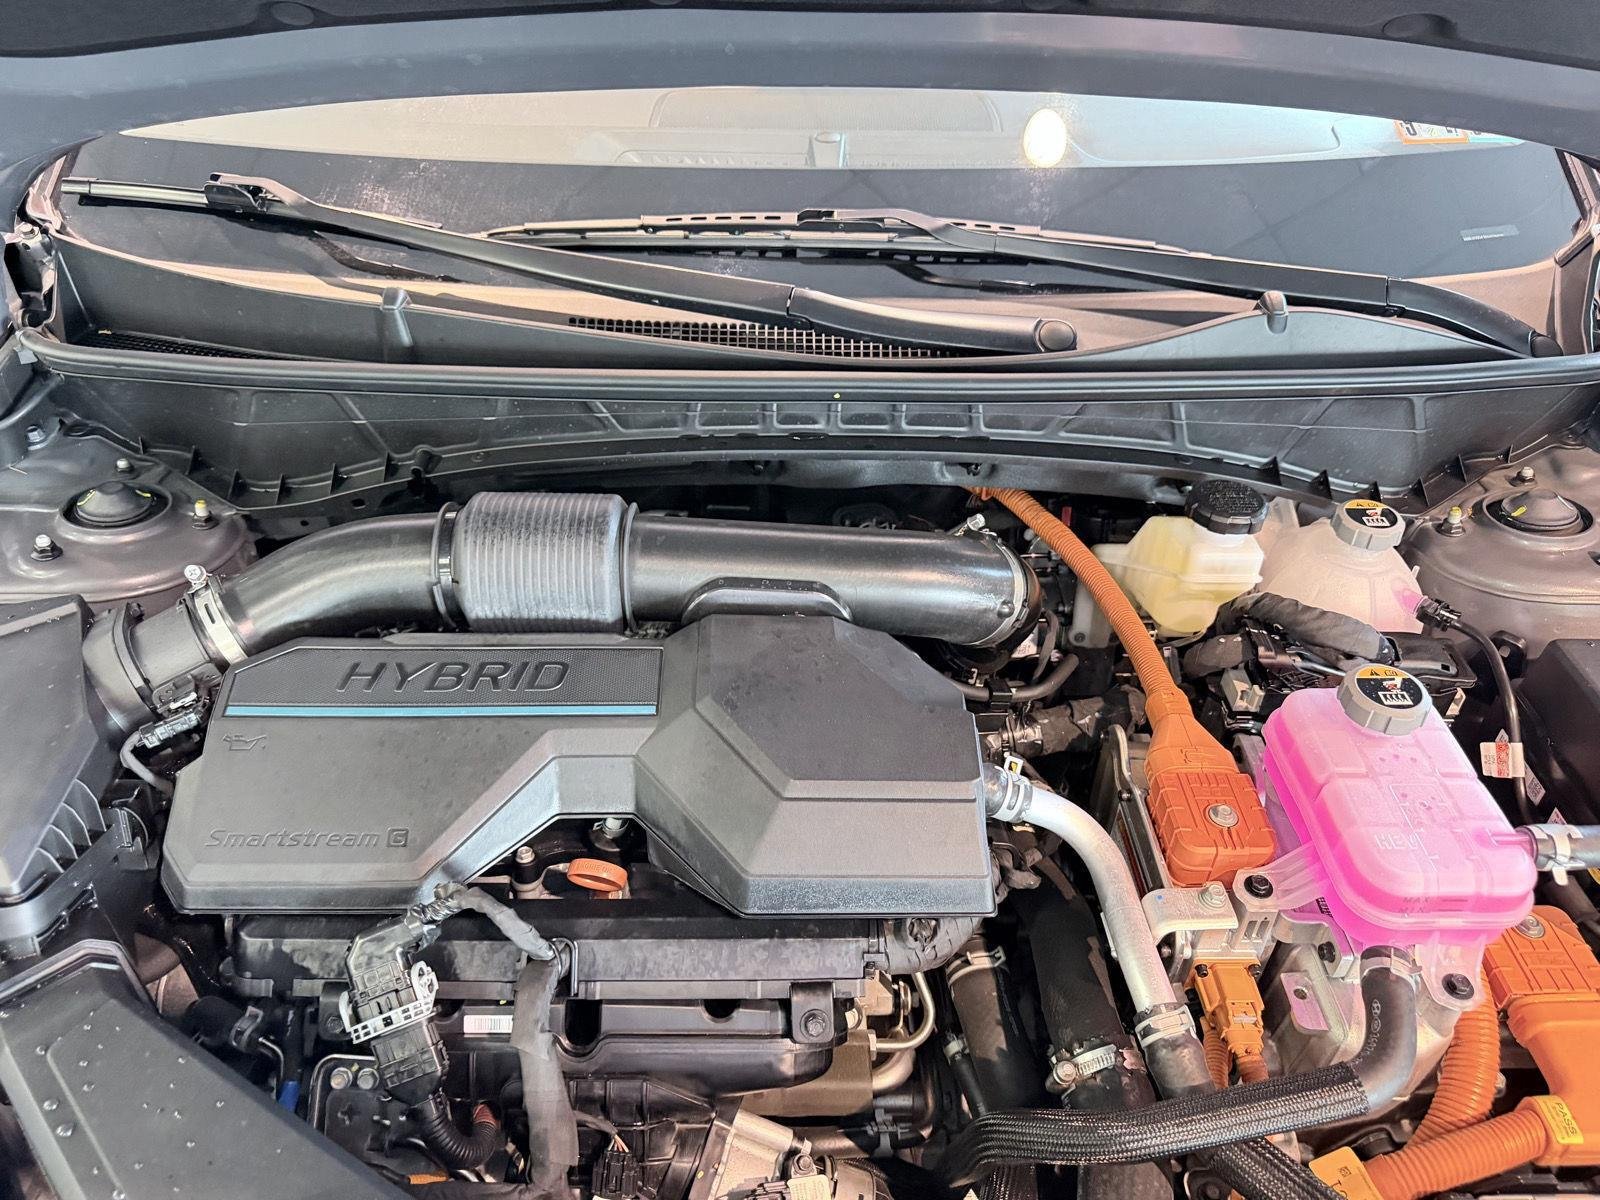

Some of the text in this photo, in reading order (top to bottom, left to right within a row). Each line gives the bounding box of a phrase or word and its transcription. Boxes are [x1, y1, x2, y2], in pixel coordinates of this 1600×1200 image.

[336, 662, 570, 692] HYBRID
[205, 827, 380, 847] Smartstream
[1555, 1102, 1577, 1136] PASS
